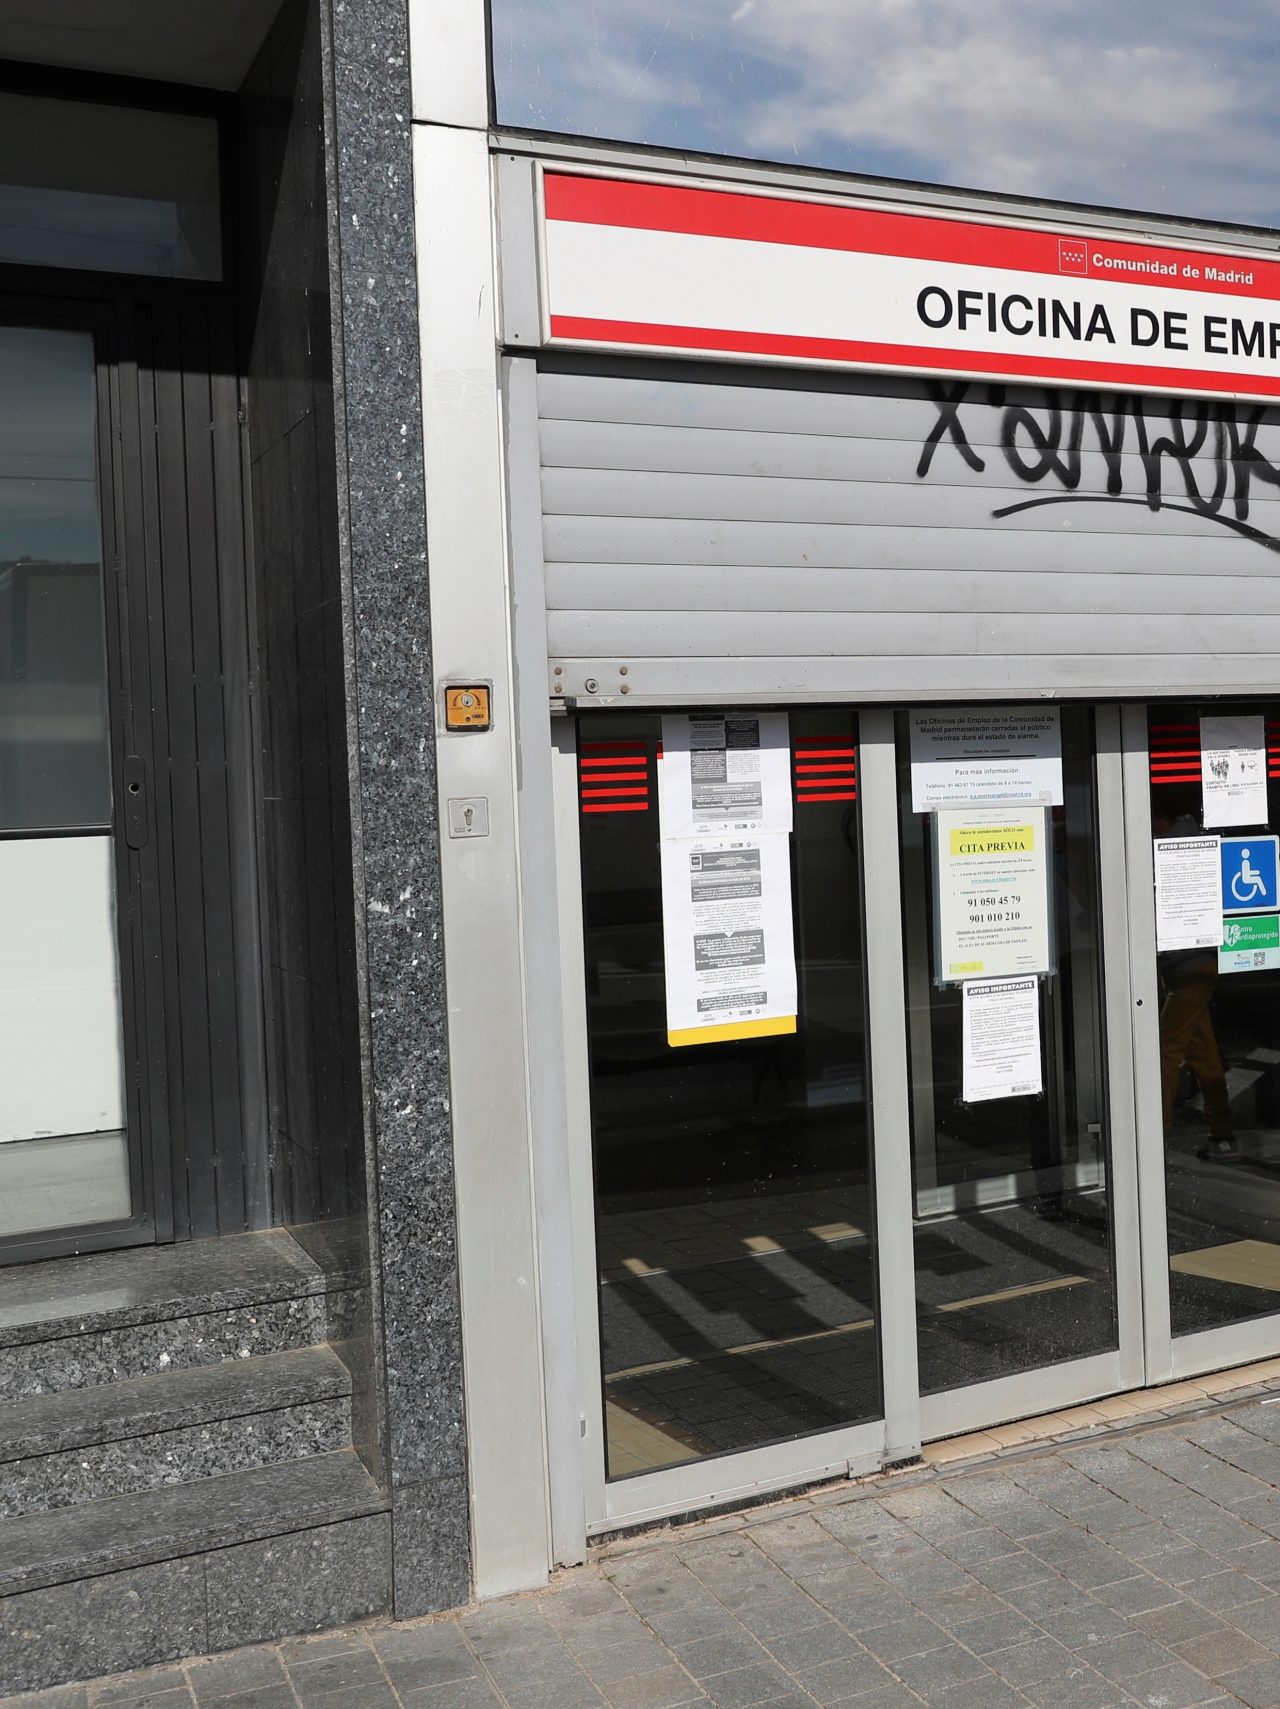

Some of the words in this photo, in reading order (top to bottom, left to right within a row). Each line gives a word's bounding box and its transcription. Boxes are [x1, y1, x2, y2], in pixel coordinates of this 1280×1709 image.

[1092, 253, 1178, 276] Comunidad
[1182, 264, 1200, 278] de
[1204, 266, 1254, 285] Madrid
[916, 285, 1116, 344] OFICINA
[1130, 308, 1189, 351] DE
[967, 717, 991, 725] Empleo
[959, 843, 984, 853] CITA
[987, 841, 1025, 851] PREVIA
[1159, 842, 1178, 850] AVISO
[1178, 840, 1216, 849] IMPORTANTE
[967, 898, 977, 907] 91
[980, 897, 996, 906] 050
[998, 896, 1009, 905] 45
[1010, 895, 1021, 904] 79
[969, 914, 984, 923] 901
[987, 913, 1003, 922] 010
[1005, 911, 1020, 921] 210
[969, 987, 990, 995] AVISO
[990, 981, 1033, 993] IMPORTANTE
